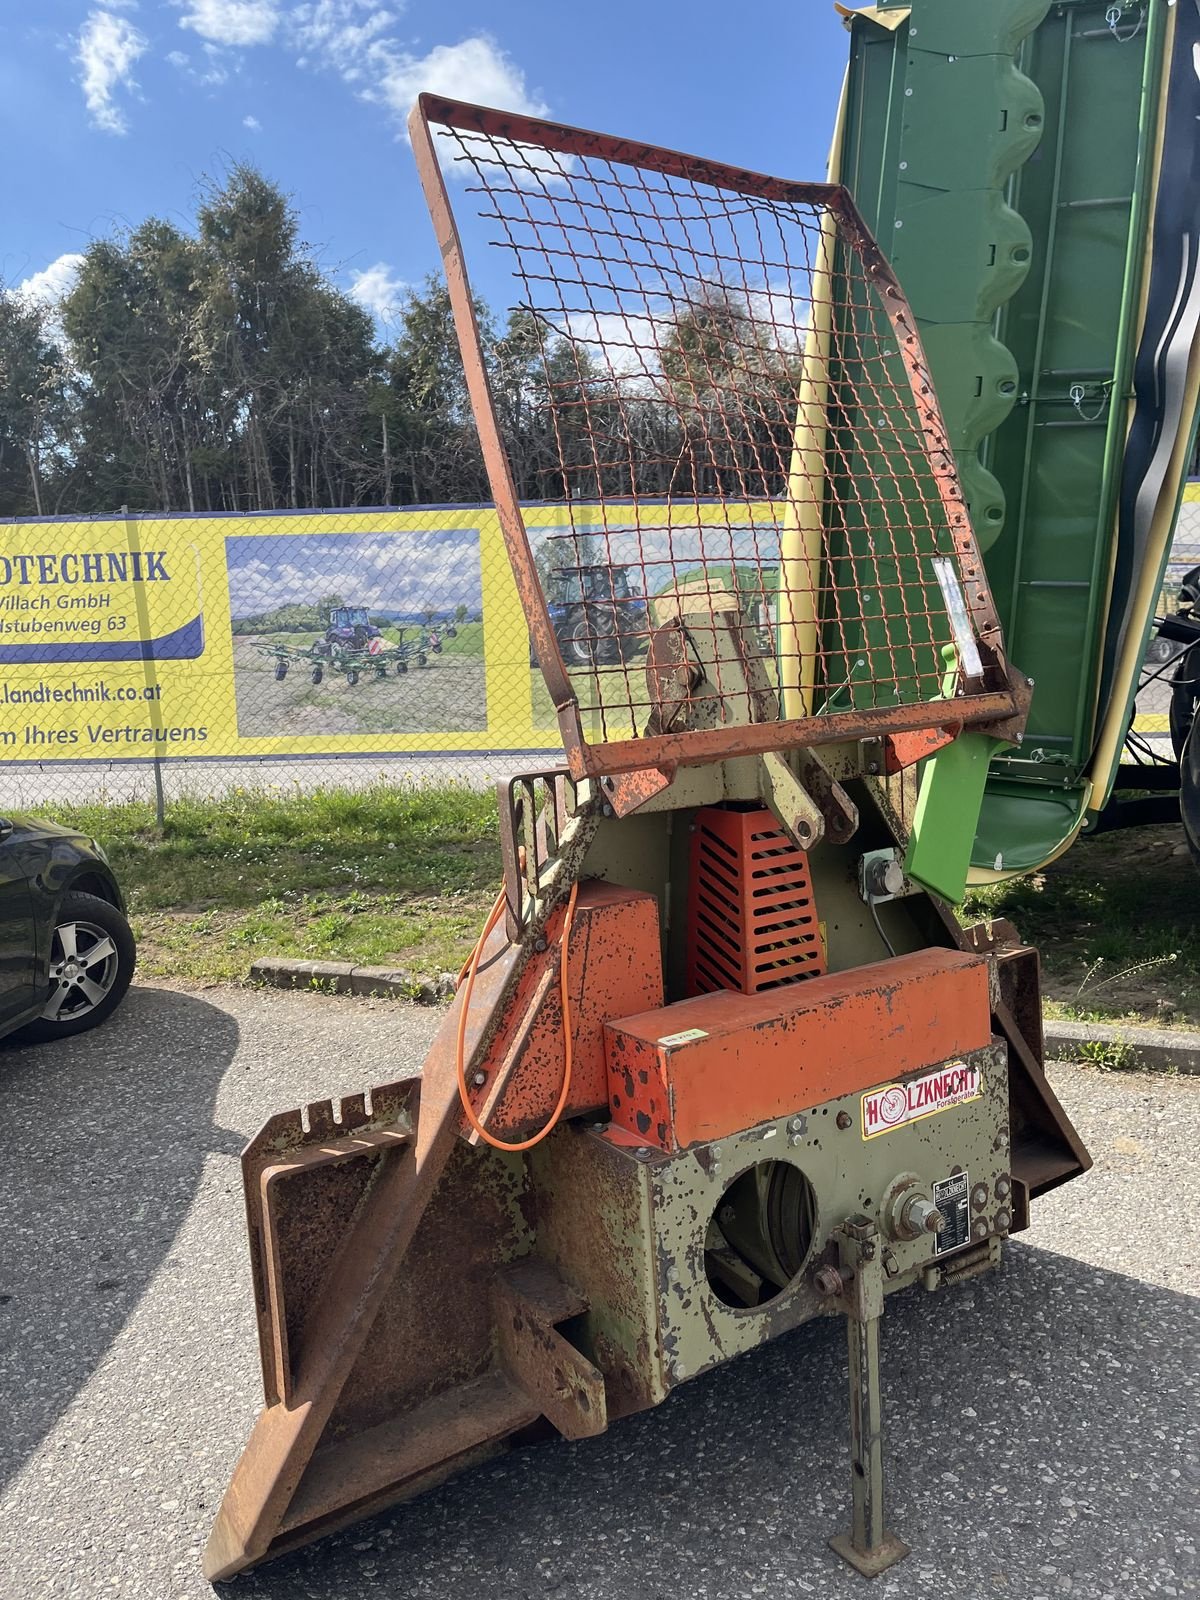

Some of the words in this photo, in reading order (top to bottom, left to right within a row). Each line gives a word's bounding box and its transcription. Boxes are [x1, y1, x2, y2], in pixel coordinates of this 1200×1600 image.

[56, 593, 111, 609] GmbH
[107, 616, 127, 631] 63
[25, 725, 79, 745] Ihres
[87, 723, 208, 744] Vertrauens
